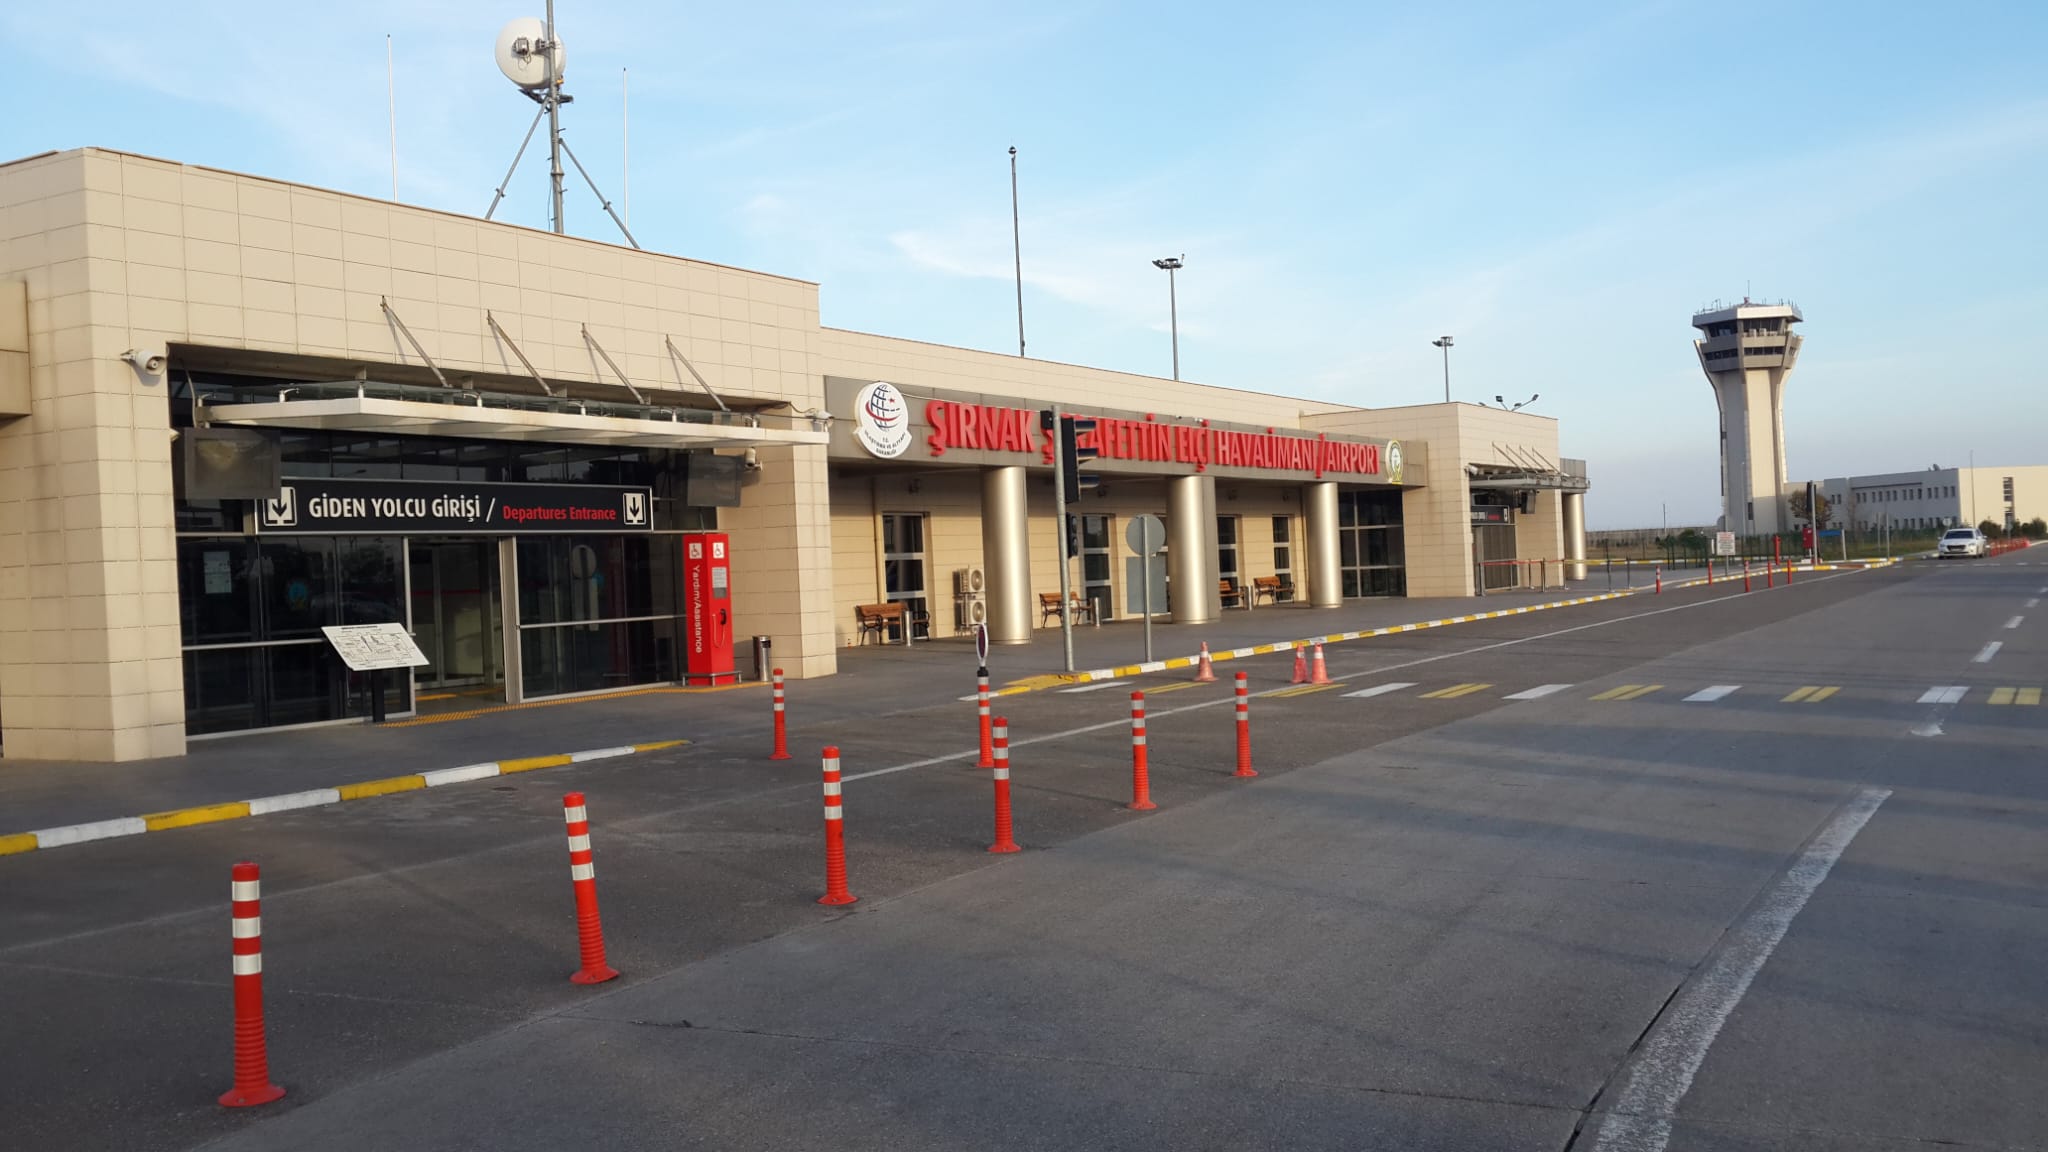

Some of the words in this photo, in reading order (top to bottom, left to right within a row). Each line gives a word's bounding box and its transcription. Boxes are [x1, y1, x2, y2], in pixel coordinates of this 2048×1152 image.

[925, 400, 1036, 457] ŞIRNAK
[1174, 419, 1212, 473] ELÇİ
[308, 493, 366, 518] GİDEN
[371, 498, 426, 518] YOLCU
[431, 494, 481, 523] GİRİŞİ
[486, 497, 496, 523] /
[503, 505, 567, 523] Departures
[569, 506, 617, 521] Entrance
